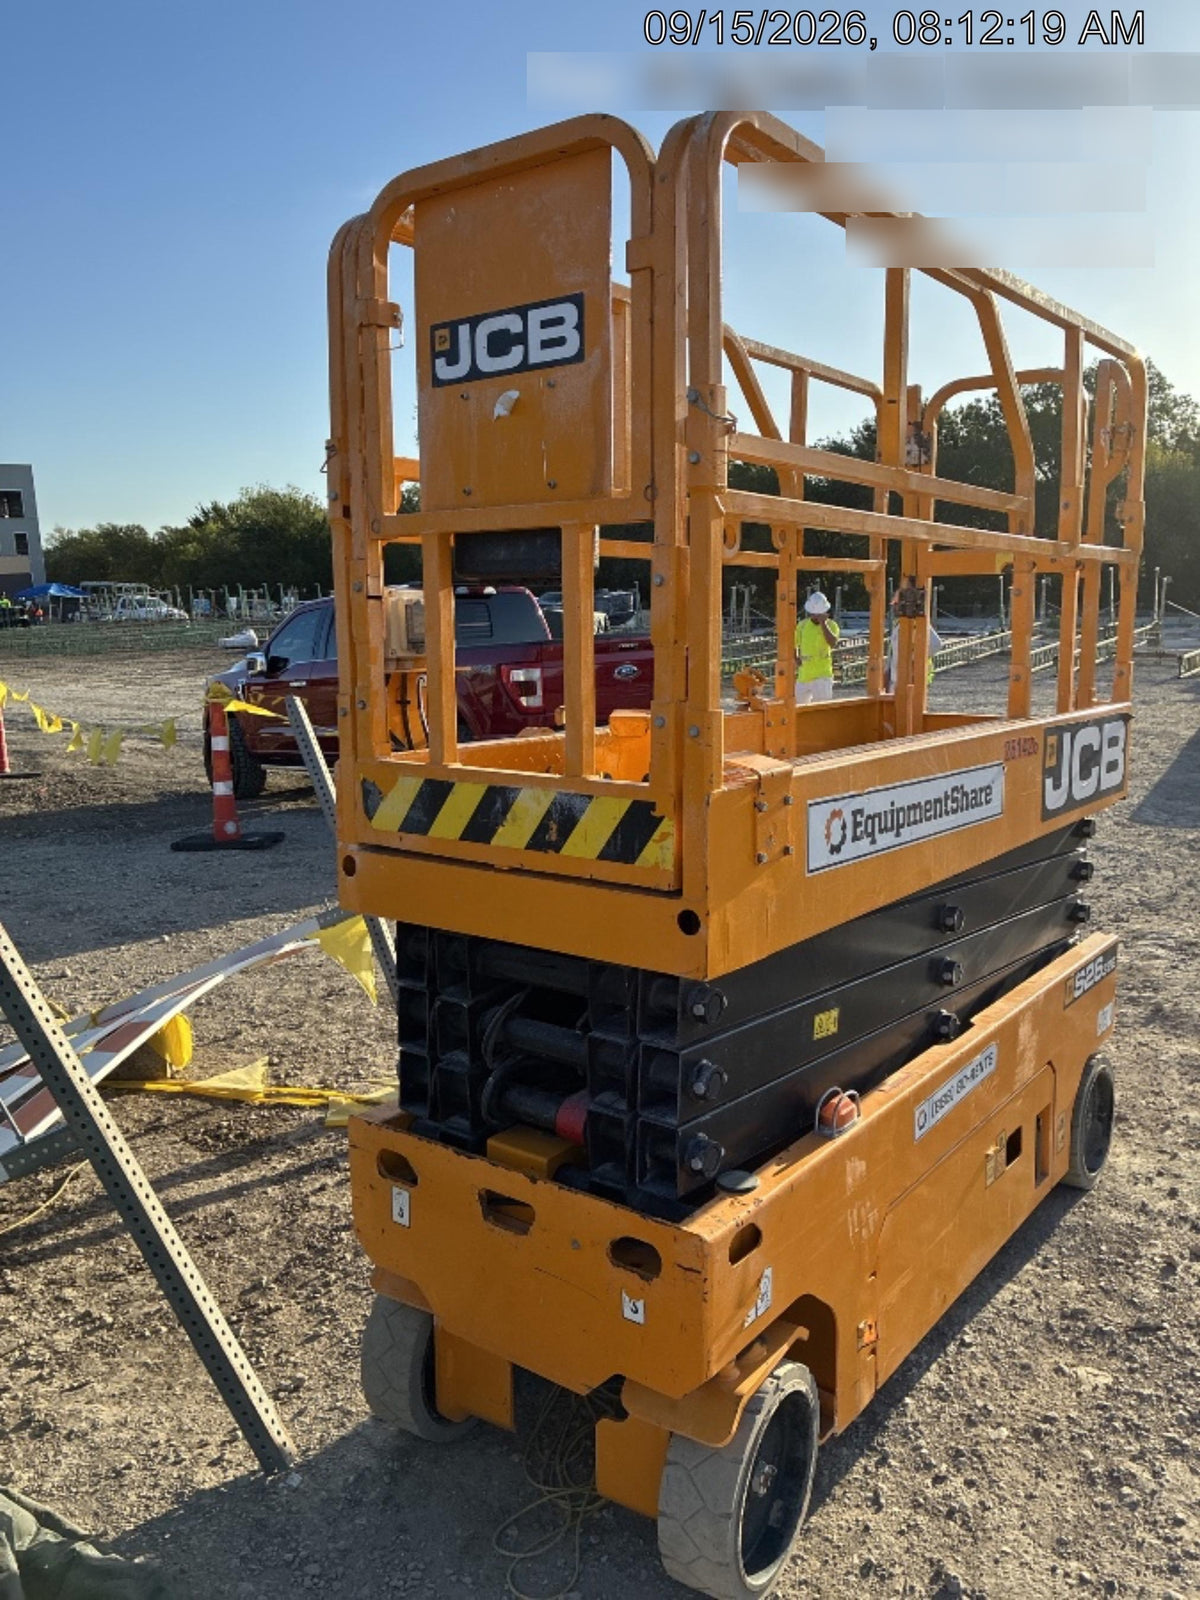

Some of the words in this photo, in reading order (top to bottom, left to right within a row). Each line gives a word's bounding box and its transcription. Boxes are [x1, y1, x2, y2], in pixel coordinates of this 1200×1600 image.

[434, 302, 581, 381] JCB
[1044, 719, 1127, 811] JCB
[851, 783, 994, 845] EquipmentShare
